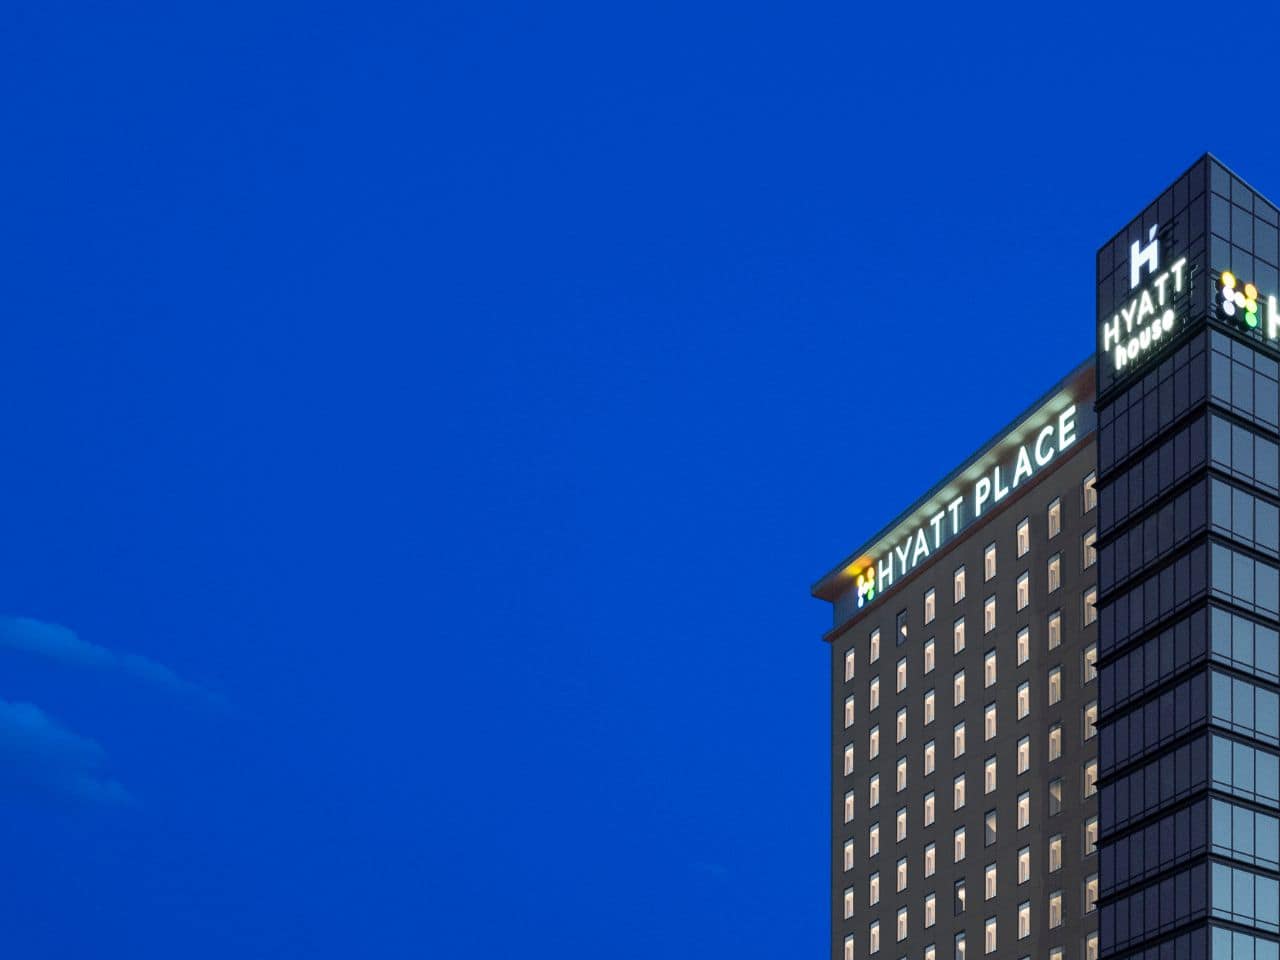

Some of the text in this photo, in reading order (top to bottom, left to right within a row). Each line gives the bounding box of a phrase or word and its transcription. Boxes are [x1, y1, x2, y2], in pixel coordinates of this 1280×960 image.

[1104, 257, 1186, 351] HYATT
[1115, 309, 1174, 370] house
[878, 496, 963, 593] HYATT
[975, 404, 1077, 517] PLACE
